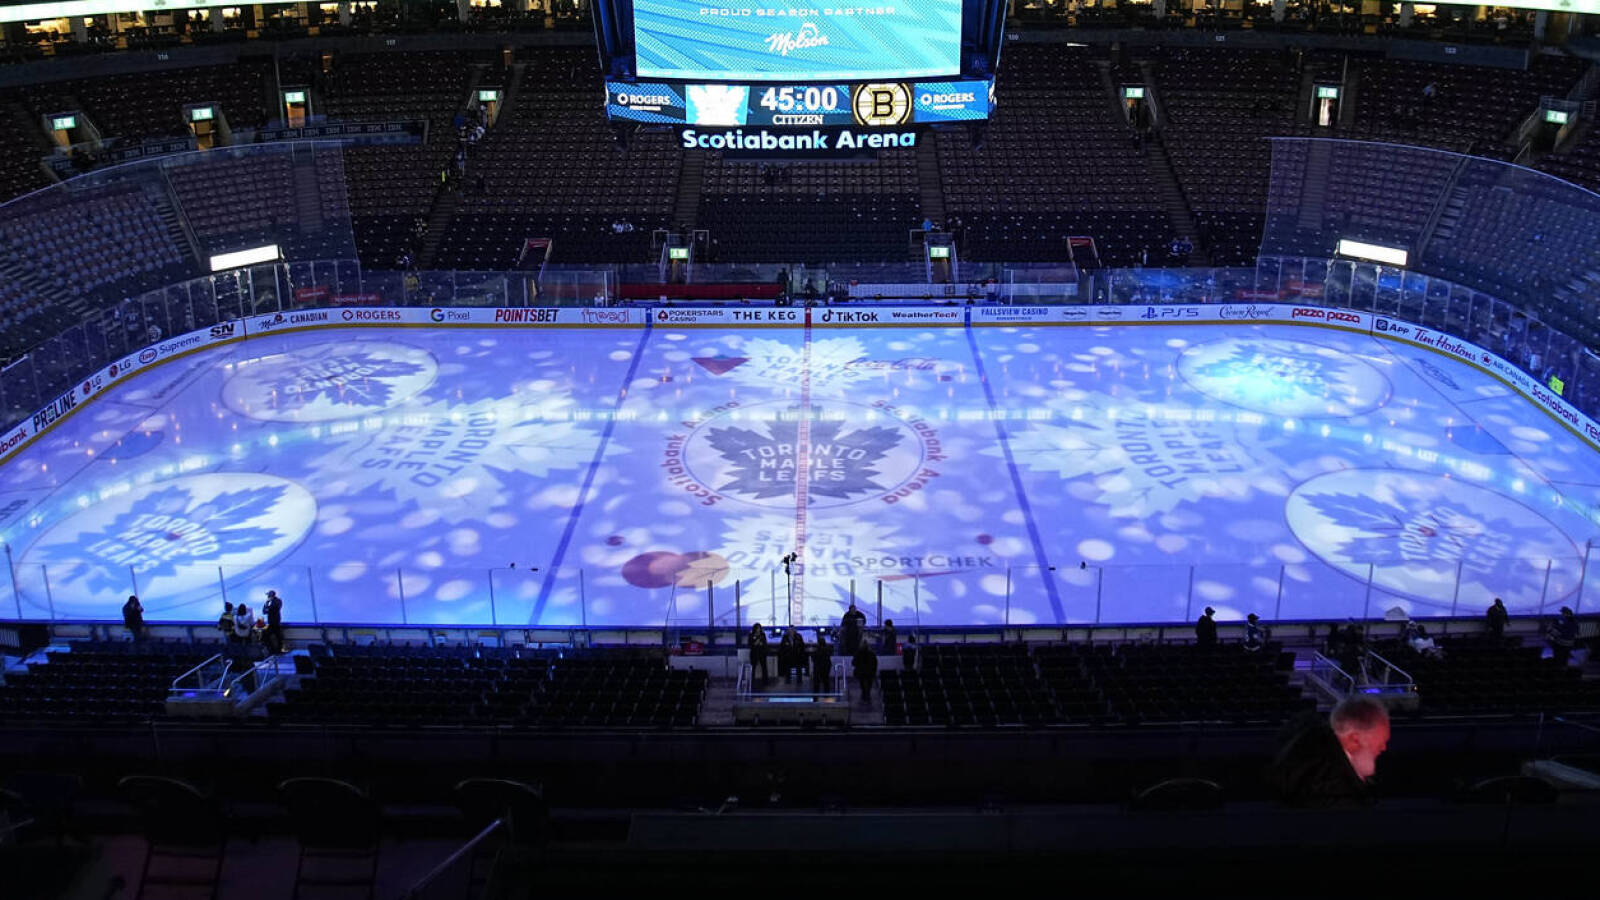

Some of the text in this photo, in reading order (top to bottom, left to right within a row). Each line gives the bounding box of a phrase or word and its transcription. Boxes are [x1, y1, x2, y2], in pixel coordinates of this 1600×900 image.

[700, 8, 896, 16] PROUD SEASON PARTNER
[765, 22, 830, 56] Molson
[629, 94, 671, 105] ROGERS
[760, 87, 838, 111] 45:00
[933, 92, 976, 103] ROGERS
[772, 114, 824, 125] CITIZEN
[682, 129, 916, 149] Scotiabank Arena
[290, 312, 329, 323] CANADIAN
[356, 311, 401, 320] ROGERS
[448, 311, 470, 320] Pixel
[495, 309, 560, 322] POINTSBET
[733, 311, 797, 320] THE KEG
[836, 312, 878, 322] TikTok
[892, 311, 958, 319] WeatherTech
[981, 307, 1049, 316] FALLSVIEW CASINO
[1161, 308, 1199, 317] PS5
[1292, 308, 1360, 323] pizza pizza
[159, 336, 201, 355] Supreme
[1414, 327, 1476, 361] Tim Hortons
[119, 359, 131, 372] LG
[1493, 360, 1530, 387] AIR CANADA
[91, 375, 102, 388] LG
[33, 390, 77, 432] PROLINE
[1531, 384, 1580, 426] Scotiabank
[873, 399, 949, 505] Scoiabank Arena
[660, 434, 723, 507] Scotiabank
[755, 529, 853, 547] LEFS
[751, 542, 851, 561] MALE
[851, 555, 993, 569] SPORTCHEK
